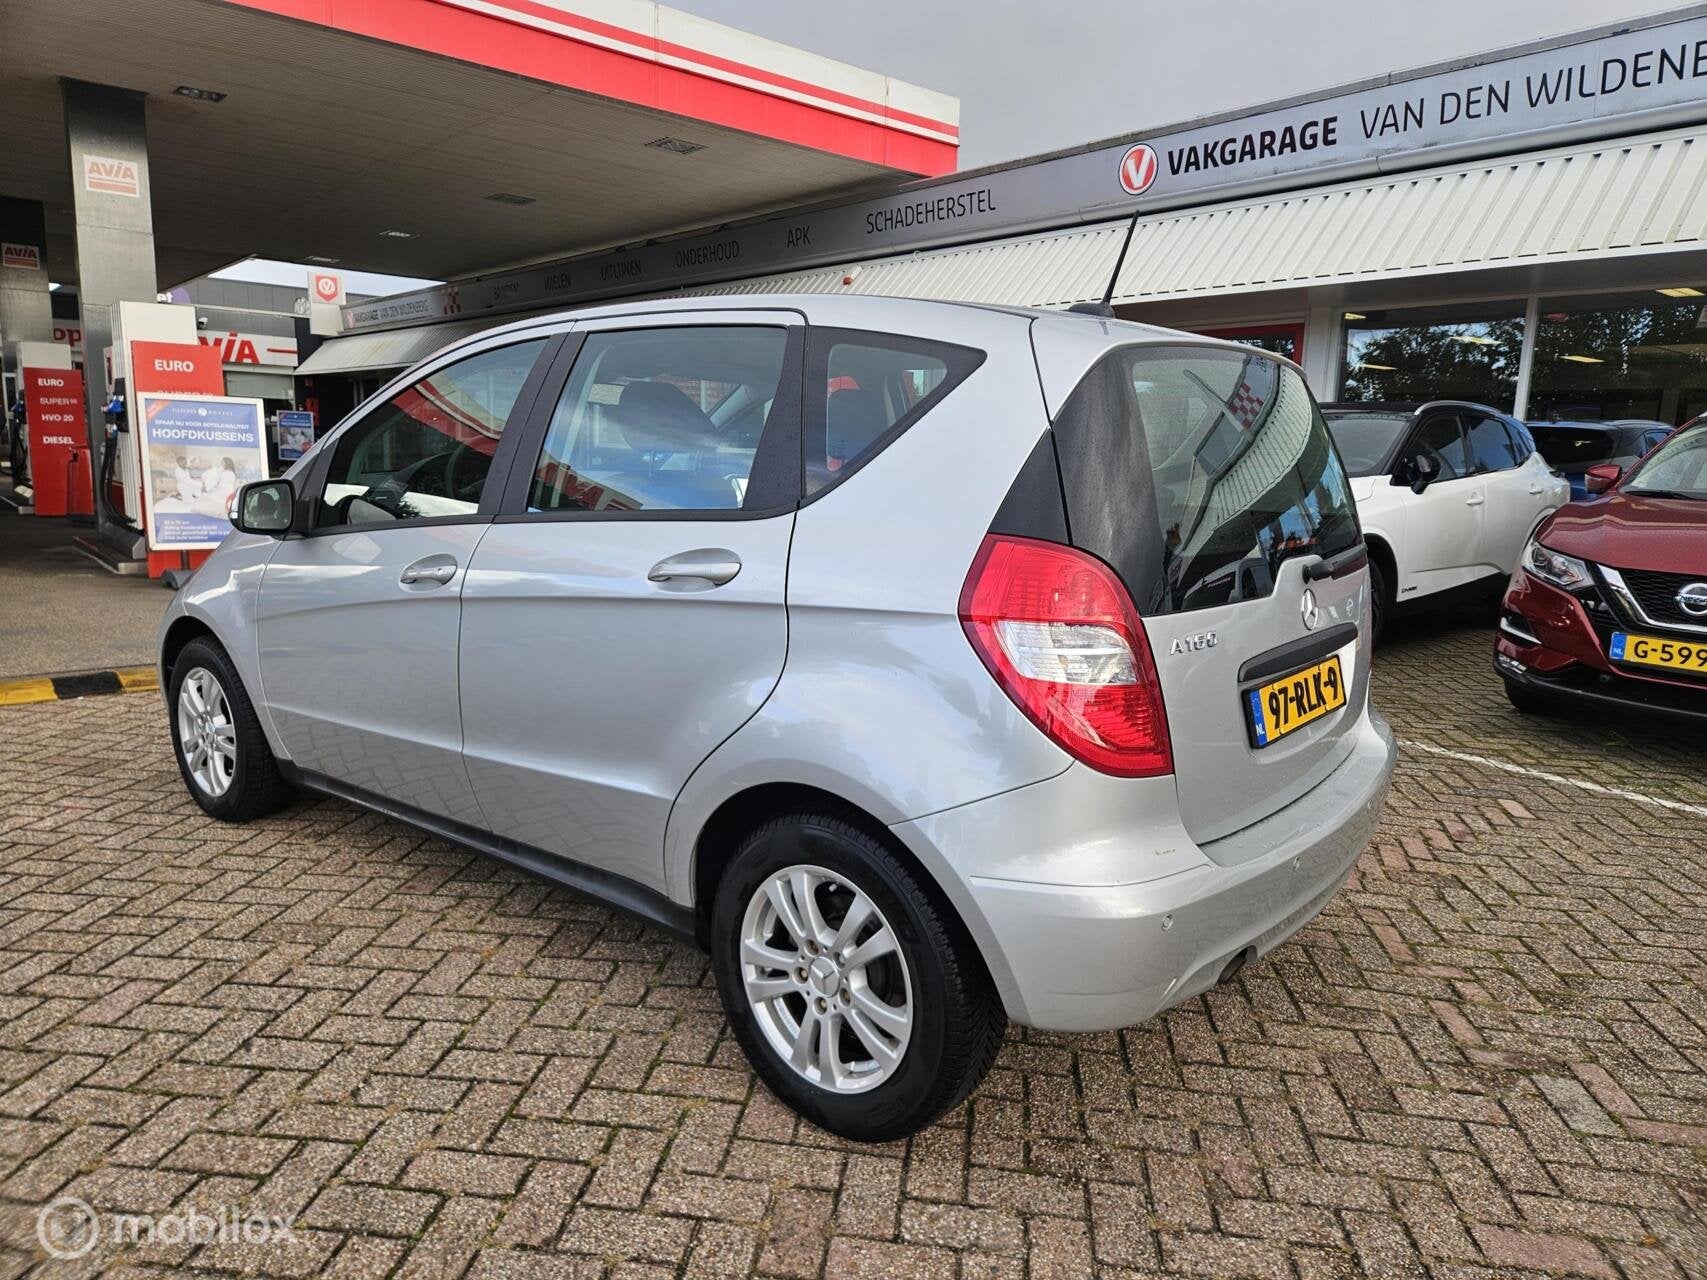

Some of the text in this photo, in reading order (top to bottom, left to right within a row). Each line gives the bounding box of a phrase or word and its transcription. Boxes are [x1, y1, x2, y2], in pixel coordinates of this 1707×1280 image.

[1167, 115, 1338, 177] VAKGARAGE
[1359, 97, 1426, 140] VAN
[1439, 80, 1511, 126] DEN
[87, 161, 136, 181] AVIA
[865, 188, 997, 234] SCHADEHERSTEL
[786, 225, 812, 249] APK
[4, 246, 38, 259] AVIA
[675, 240, 740, 269] ONDERHOUD
[154, 359, 194, 373] EURO
[37, 378, 64, 387] EURO
[41, 413, 62, 422] HVO
[43, 436, 75, 444] DIESEL
[152, 428, 254, 443] HOOFDKUSSENS
[1268, 666, 1339, 731] 97-RLK-9
